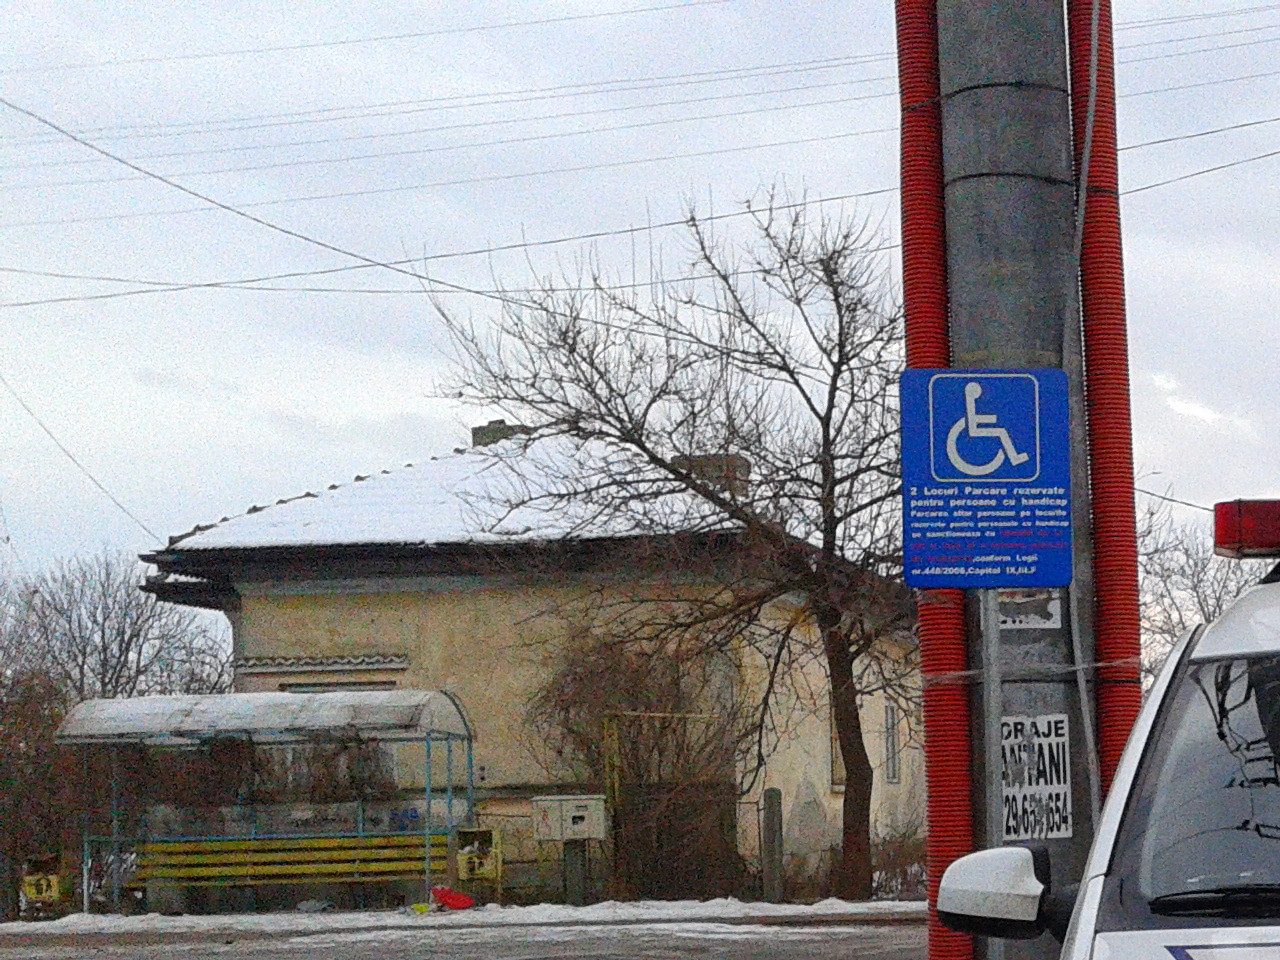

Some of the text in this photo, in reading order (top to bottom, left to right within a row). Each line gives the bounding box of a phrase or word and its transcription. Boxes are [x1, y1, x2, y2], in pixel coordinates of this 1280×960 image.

[910, 486, 1066, 496] 2 Locuri Parcare rezervate
[910, 499, 944, 507] pentru
[950, 499, 997, 507] persoane
[1021, 497, 1068, 507] handicap
